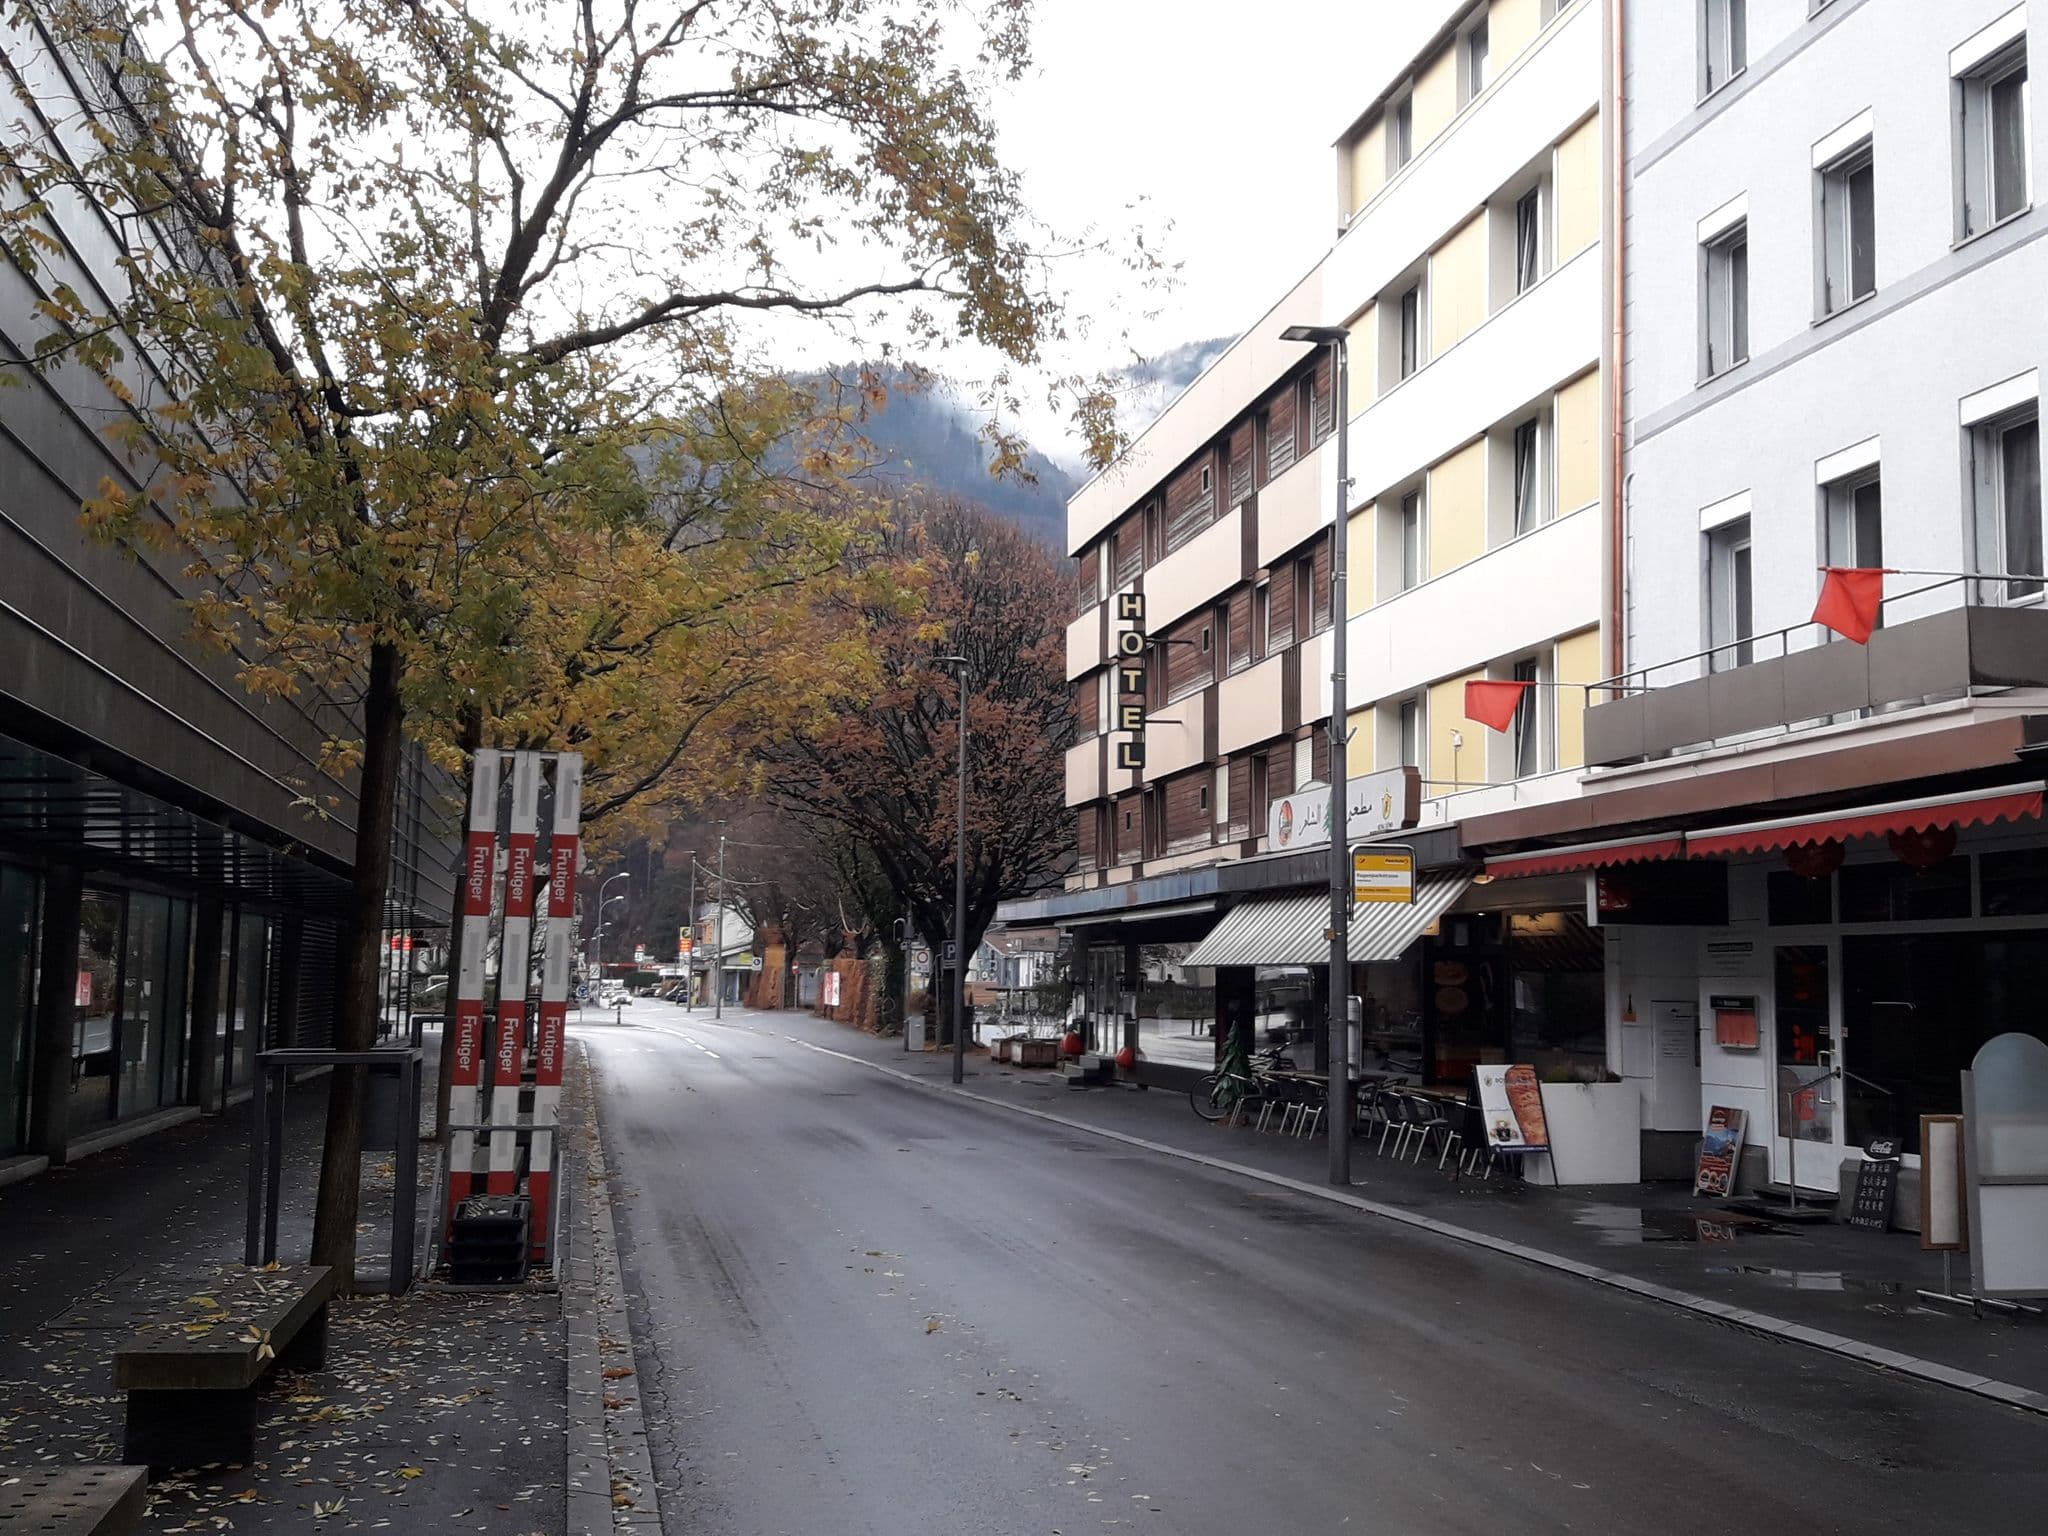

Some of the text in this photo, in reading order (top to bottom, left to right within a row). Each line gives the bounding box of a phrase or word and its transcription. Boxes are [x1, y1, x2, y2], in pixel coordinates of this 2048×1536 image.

[1121, 596, 1144, 766] HOTEL
[469, 846, 489, 901] Frutiger
[510, 847, 529, 902] Frutiger
[552, 848, 572, 903] Frutiger
[947, 944, 956, 959] P
[457, 1015, 477, 1071] Frutiger
[498, 1017, 519, 1074] Frutiger
[539, 1015, 560, 1072] Frutiger
